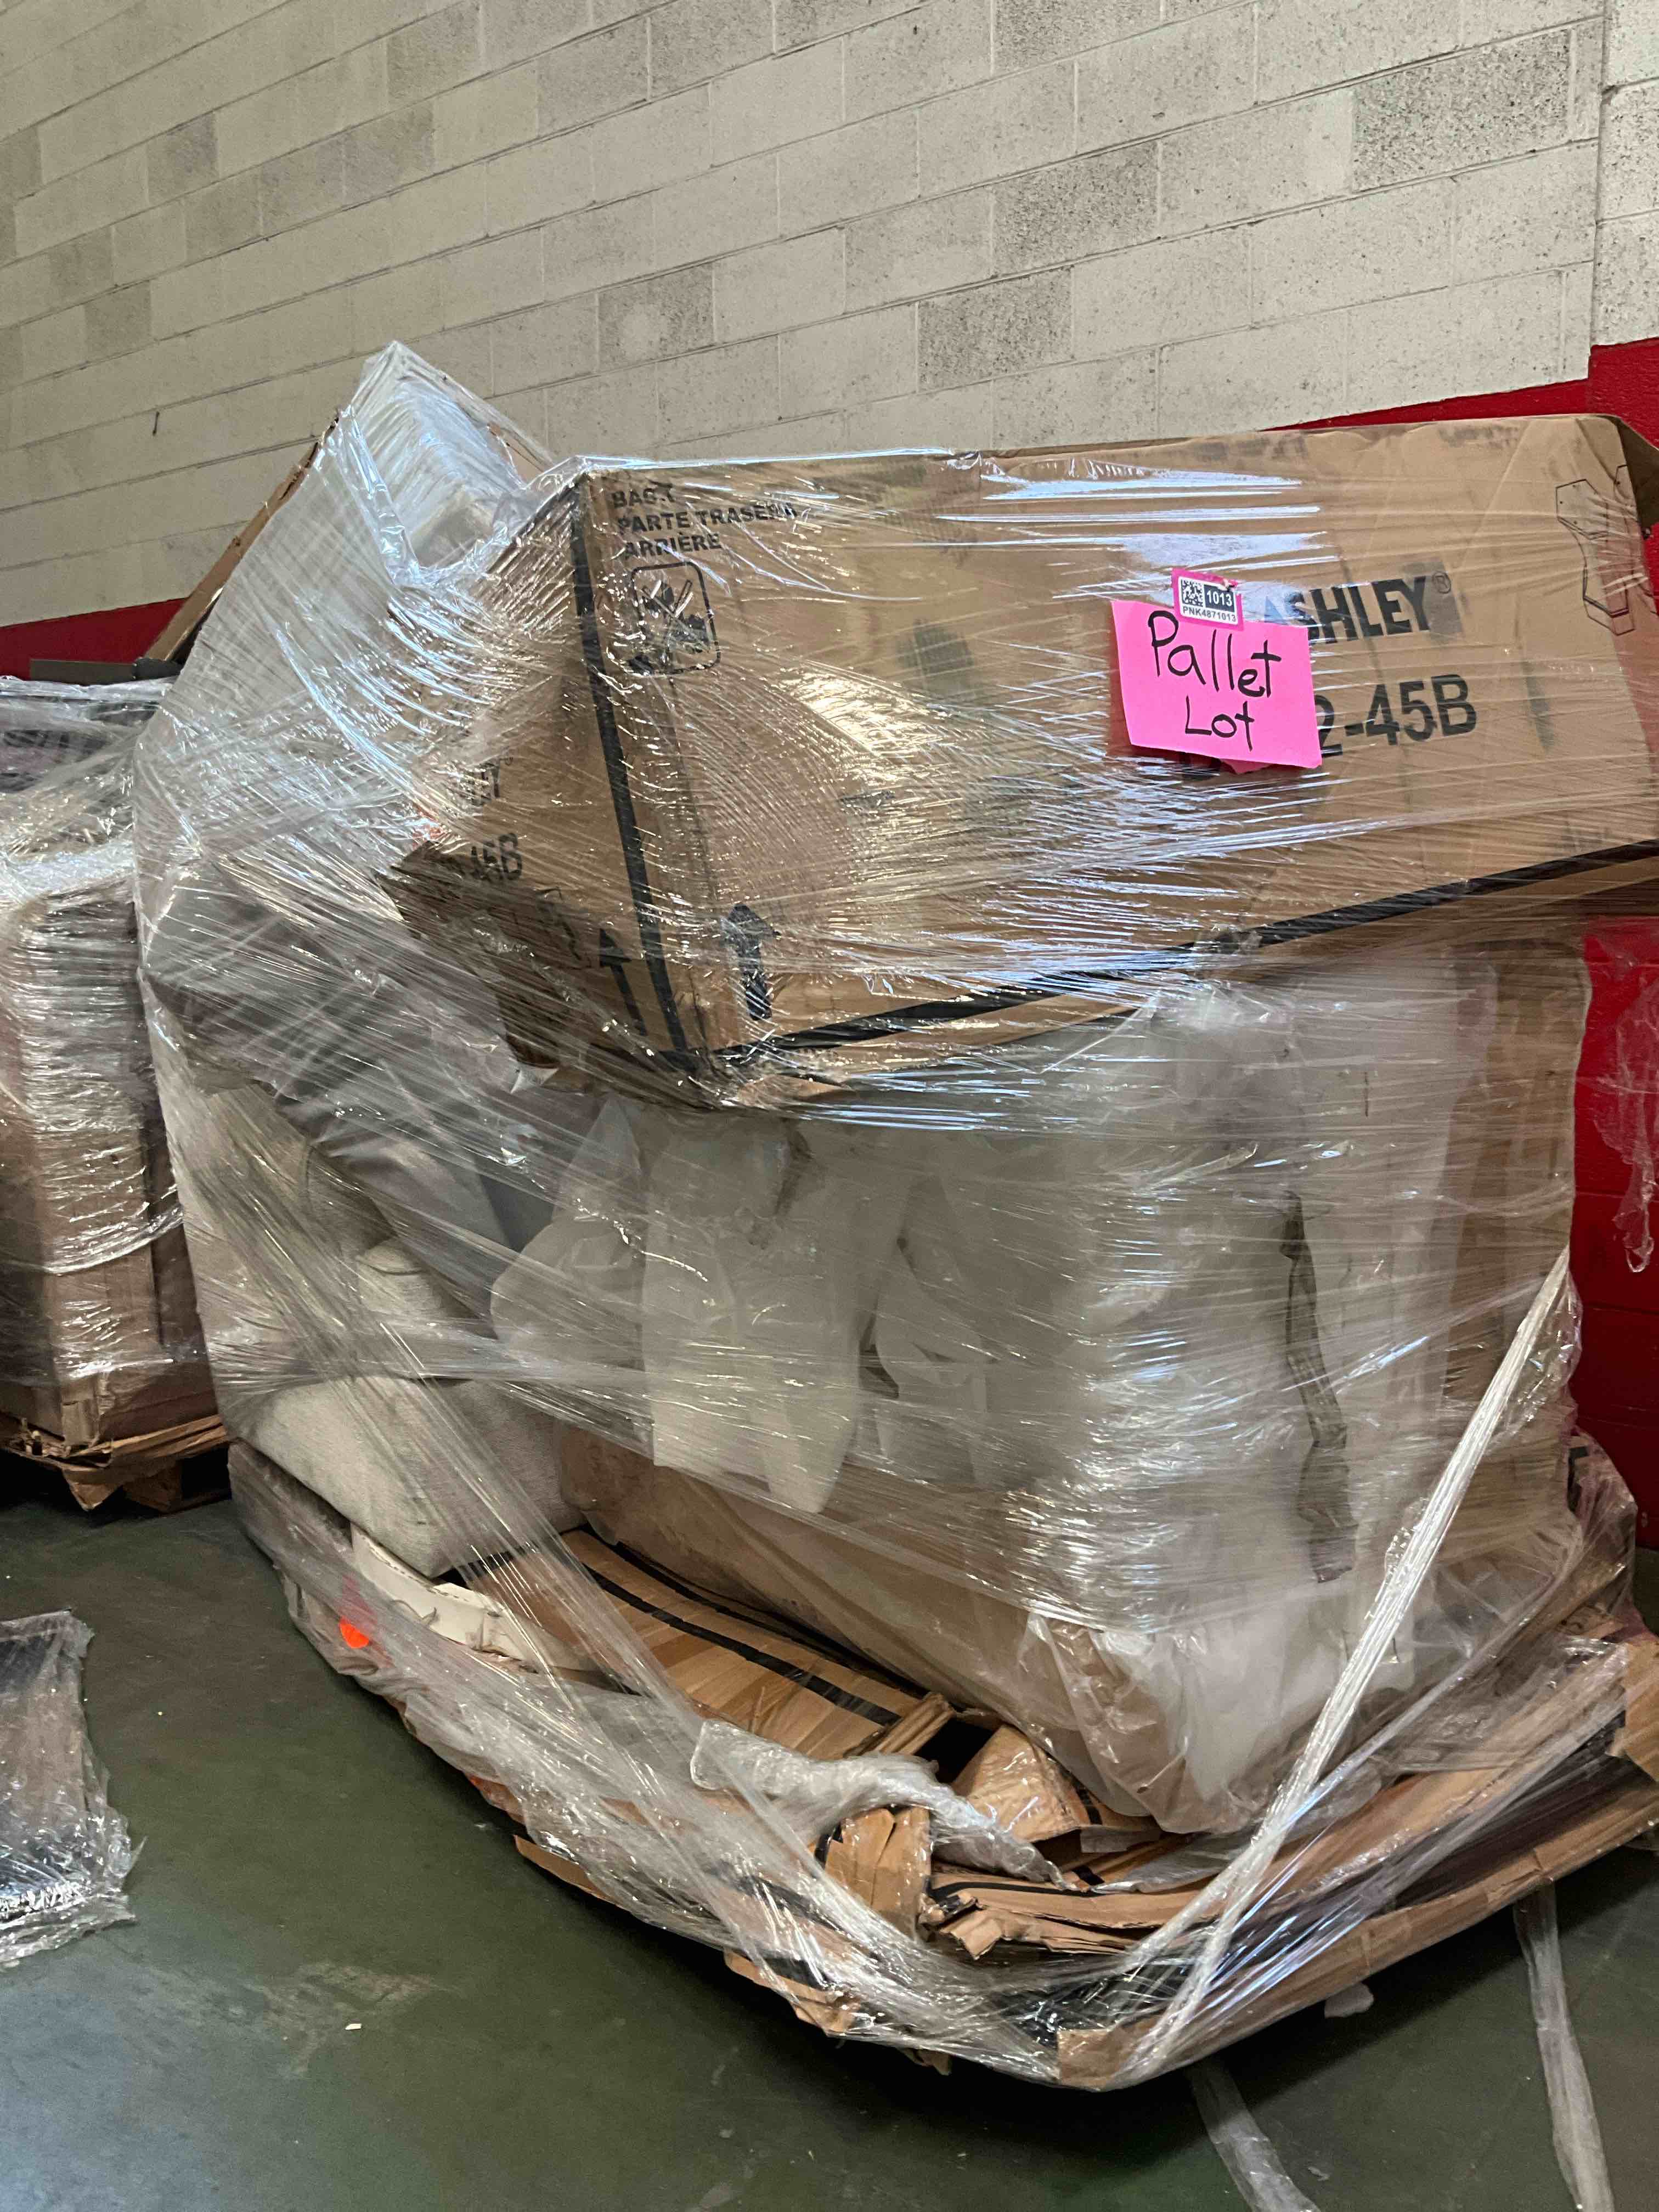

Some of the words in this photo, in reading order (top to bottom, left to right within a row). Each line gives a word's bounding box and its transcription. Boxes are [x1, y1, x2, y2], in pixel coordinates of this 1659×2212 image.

[617, 510, 690, 535] PARTE
[623, 529, 721, 560] ARRIÈRE
[1206, 590, 1233, 607] 1013
[1182, 605, 1237, 622] PNK4871013
[1148, 610, 1282, 698] Pallet
[1185, 695, 1255, 752] Lot
